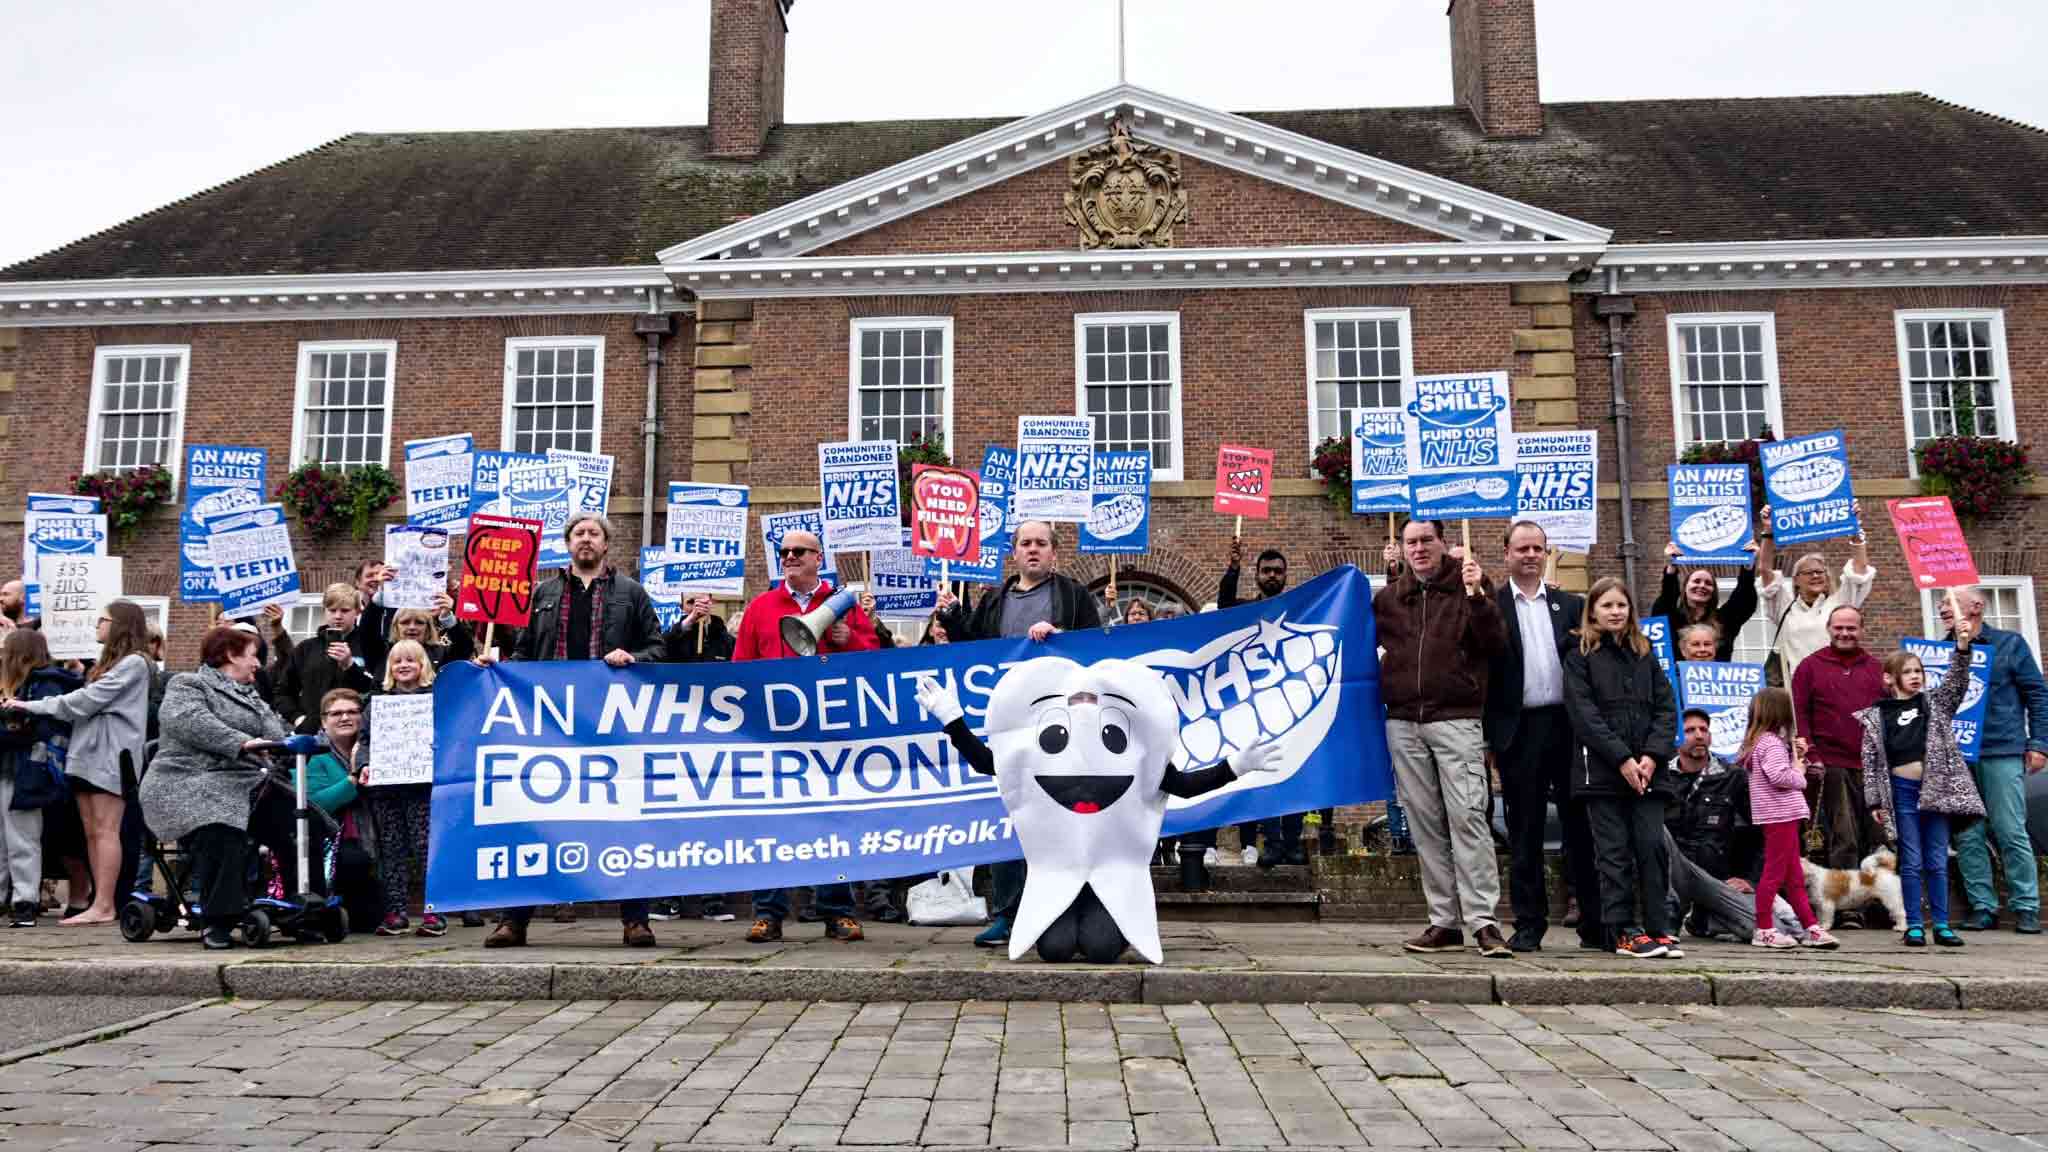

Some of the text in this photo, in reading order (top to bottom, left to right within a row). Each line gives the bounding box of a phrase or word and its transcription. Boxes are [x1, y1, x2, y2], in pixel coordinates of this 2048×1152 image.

[1419, 380, 1491, 394] MAKE US
[1420, 392, 1492, 412] SMILE
[1024, 420, 1090, 428] COMMUNITIES
[1364, 414, 1396, 423] MAKE
[1023, 428, 1090, 436] ABANDONED
[1364, 422, 1404, 436] SMIL
[1422, 427, 1495, 441] FUND OUR
[1518, 435, 1592, 444] COMMUNITIES
[824, 445, 892, 455] COMMUNITIES
[1023, 445, 1089, 454] BRING BACK
[1364, 448, 1393, 456] FUND
[1424, 438, 1495, 467] NHS
[1518, 444, 1591, 454] ABANDONED
[1764, 436, 1838, 458] WANTED
[192, 450, 262, 466] AN NHS
[478, 454, 500, 468] AN
[550, 452, 610, 464] COMMUNITIES
[824, 453, 893, 464] ABANDONED
[986, 451, 1012, 468] AN
[1111, 456, 1147, 470] NHS
[192, 464, 259, 478] DENTIST
[546, 467, 566, 478] US
[1022, 454, 1088, 478] NHS
[1518, 462, 1592, 472] BRING BACK
[824, 470, 894, 482] BRING BACK
[1096, 472, 1146, 484] ENTIST
[1673, 468, 1745, 482] AN NHS
[512, 476, 568, 494] SMILE
[930, 484, 963, 498] YOU
[1022, 478, 1088, 490] DENTISTS
[1518, 472, 1591, 498] NHS
[1674, 483, 1744, 496] DENTIST
[411, 484, 469, 504] TEETH
[827, 480, 894, 506] NHS
[512, 500, 568, 512] FUND OUR
[926, 498, 967, 512] NEED
[1518, 498, 1591, 510] DENTISTS
[1774, 498, 1849, 516] HEALTHY TEETH
[828, 504, 896, 519] DENTISTS
[1776, 506, 1850, 530] ON NHS
[38, 518, 94, 528] MAKE US
[472, 518, 540, 533] Communists say
[772, 514, 818, 528] MAKE US
[918, 510, 976, 528] FILLING
[38, 528, 94, 541] SMILE
[940, 527, 956, 538] IN
[480, 536, 522, 552] KEEP
[672, 537, 740, 556] TEETH
[220, 556, 289, 580] TEETH
[480, 558, 520, 576] NHS
[672, 560, 736, 570] no return to
[681, 568, 727, 580] pre-NHS
[874, 574, 932, 588] TEETH
[184, 578, 205, 590] ON
[244, 580, 277, 594] return
[280, 576, 290, 584] to
[463, 574, 530, 596] PUBLIC
[884, 599, 922, 610] pre-NHS
[888, 594, 918, 602] return
[1686, 666, 1760, 682] AN NHS
[1165, 646, 1287, 722] NHS
[1688, 682, 1760, 696] DENTIST
[480, 684, 576, 736] AN
[596, 683, 748, 734] NHS
[483, 752, 618, 806] FOR
[598, 816, 1014, 876] @SuffolkTeeth #SuffolkT
